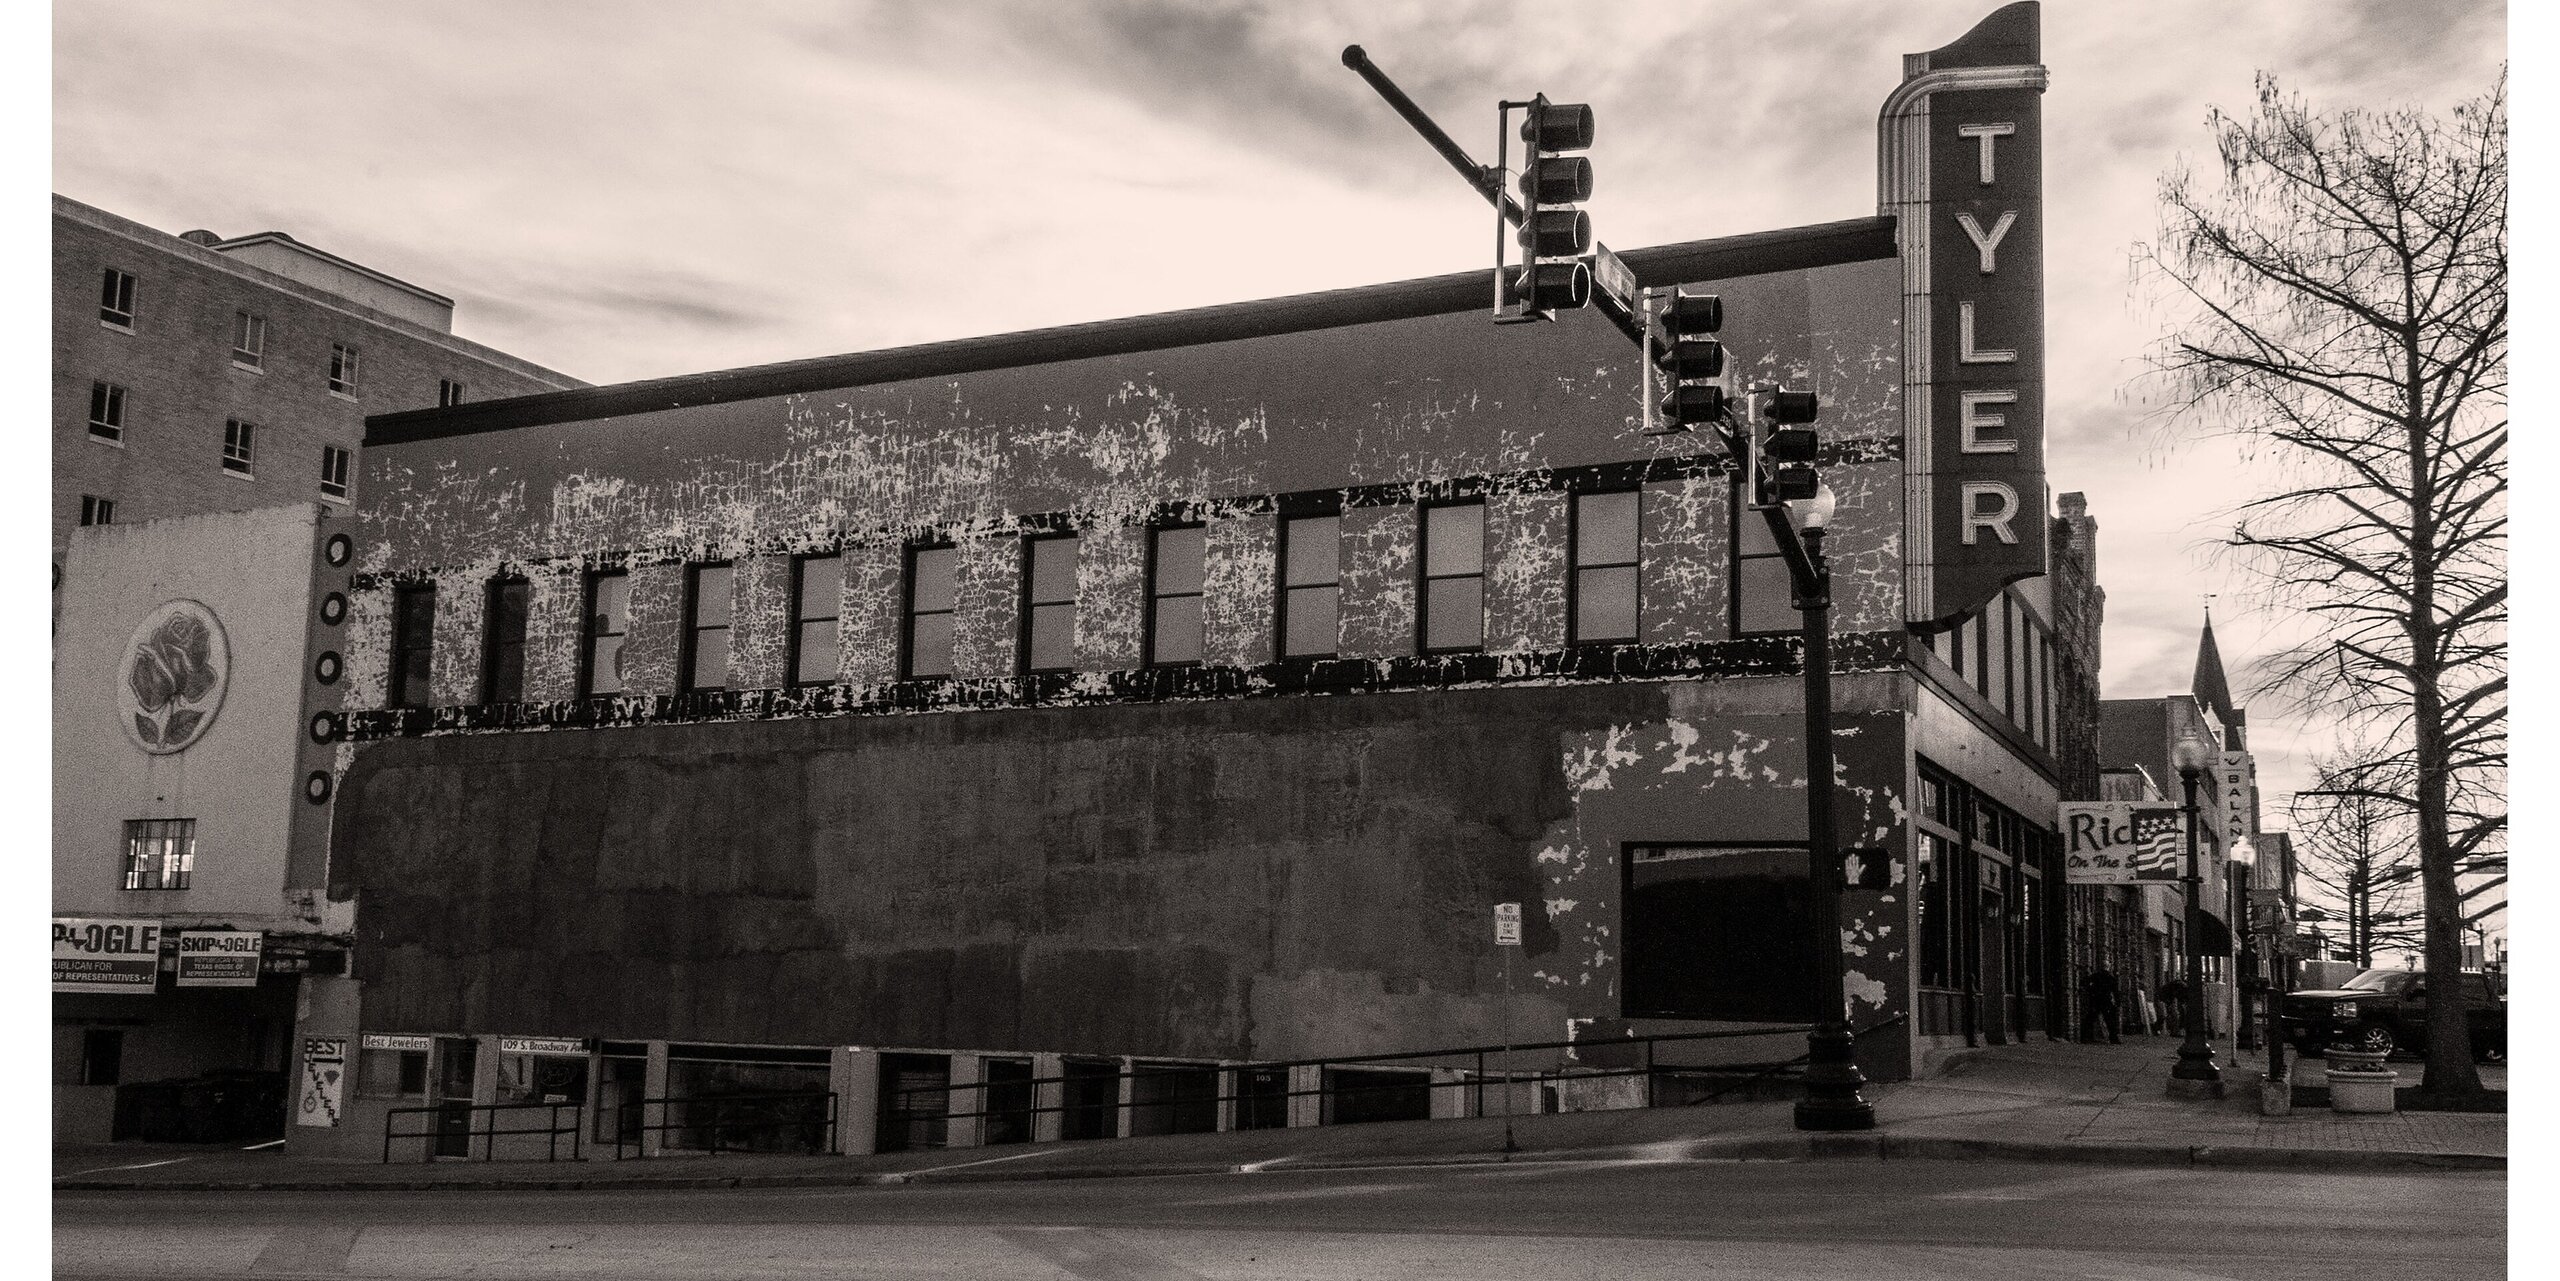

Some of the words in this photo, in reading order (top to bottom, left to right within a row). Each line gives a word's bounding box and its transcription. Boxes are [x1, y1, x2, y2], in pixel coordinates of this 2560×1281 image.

[1955, 122, 2019, 546] TYLER
[2228, 775, 2243, 848] BALAN
[2068, 855, 2089, 868] On
[2093, 855, 2120, 868] The
[1503, 905, 1513, 914] NO
[84, 924, 159, 954] OGLE
[181, 937, 216, 952] SKIP
[224, 937, 261, 952] OGLE
[94, 961, 113, 971] FOR
[53, 971, 64, 980] OF
[65, 972, 140, 982] REPRESENTATIVES
[305, 1037, 348, 1055] BEST
[364, 1036, 385, 1047] Best
[388, 1036, 429, 1049] Jewelers
[503, 1040, 519, 1050] 109
[520, 1040, 527, 1050] S.
[529, 1040, 569, 1054] Broadway
